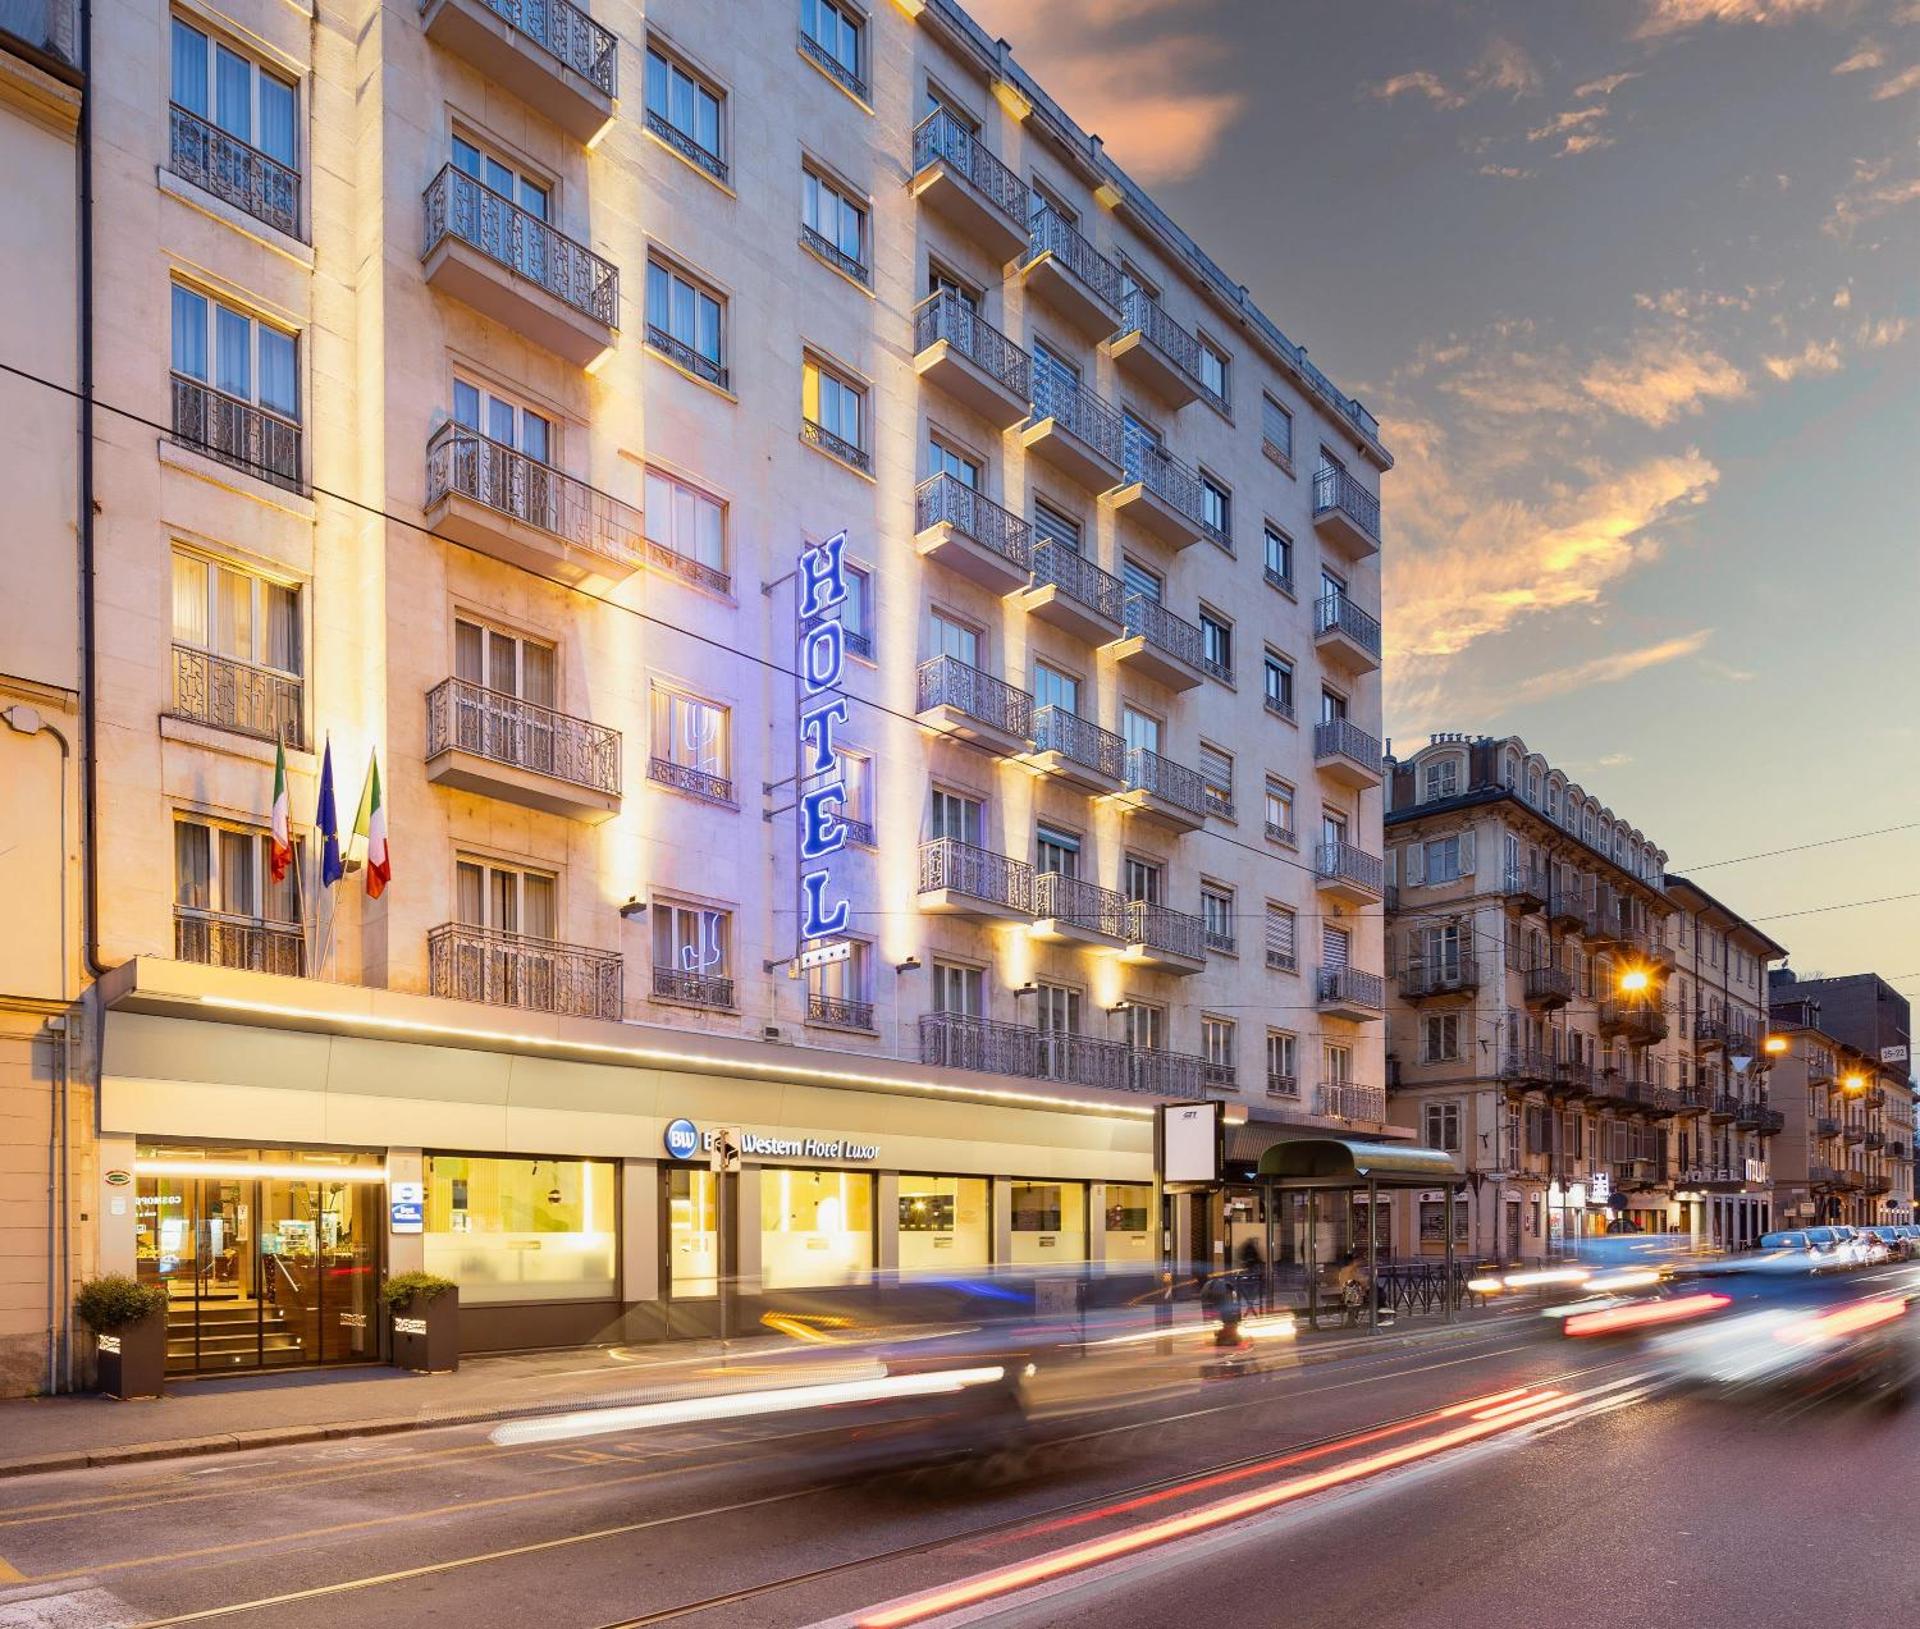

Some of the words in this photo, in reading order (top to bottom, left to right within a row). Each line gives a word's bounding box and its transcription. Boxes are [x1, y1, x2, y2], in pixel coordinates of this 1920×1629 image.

[800, 530, 850, 938] HOTEL
[670, 1131, 695, 1149] BW
[741, 1134, 801, 1156] Western
[804, 1139, 843, 1158] Hotel
[845, 1141, 881, 1159] Luxor
[1678, 1167, 1744, 1183] HOTEL
